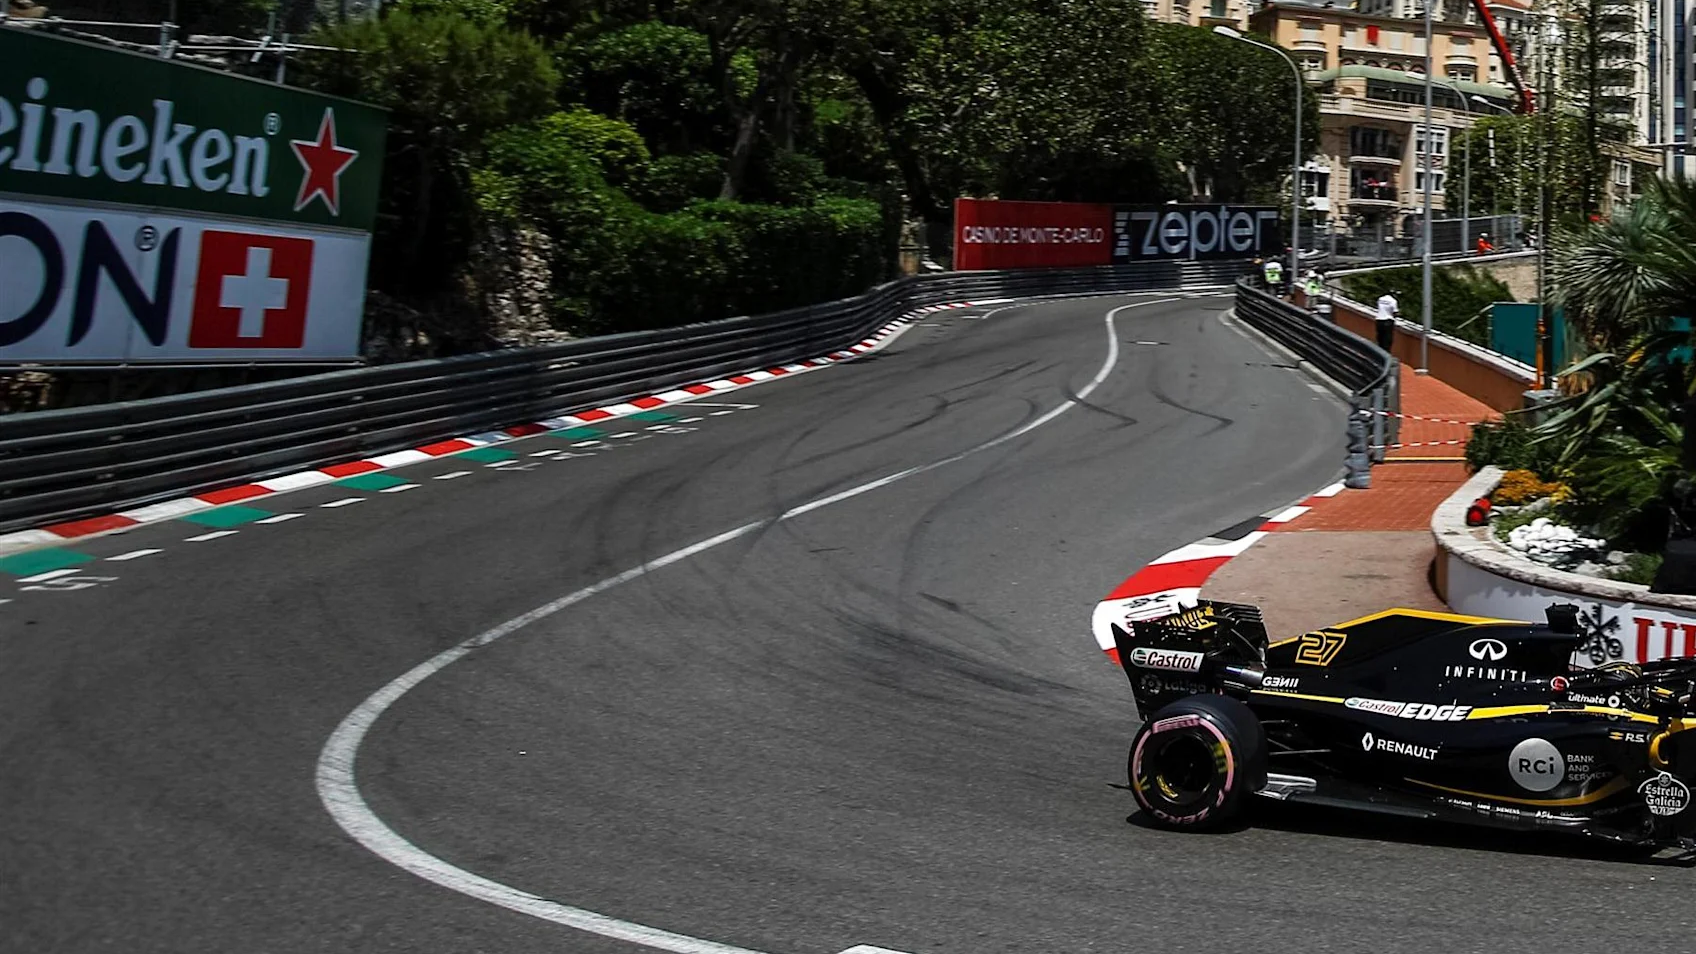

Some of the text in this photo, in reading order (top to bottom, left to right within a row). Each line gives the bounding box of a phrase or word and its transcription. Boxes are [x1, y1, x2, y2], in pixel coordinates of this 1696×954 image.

[962, 226, 1105, 243] CASINO DE MONTE-CARLO
[1295, 630, 1347, 666] 27
[1149, 651, 1198, 670] Castrol
[1445, 665, 1527, 682] INFINITI
[1358, 700, 1473, 721] Castrol EDGE
[1377, 738, 1438, 760] RENAULT
[1519, 756, 1555, 775] RCi
[1567, 754, 1595, 763] BANK
[1568, 764, 1590, 773] AND
[1645, 784, 1684, 797] Estrella
[1646, 795, 1681, 807] Galicia
